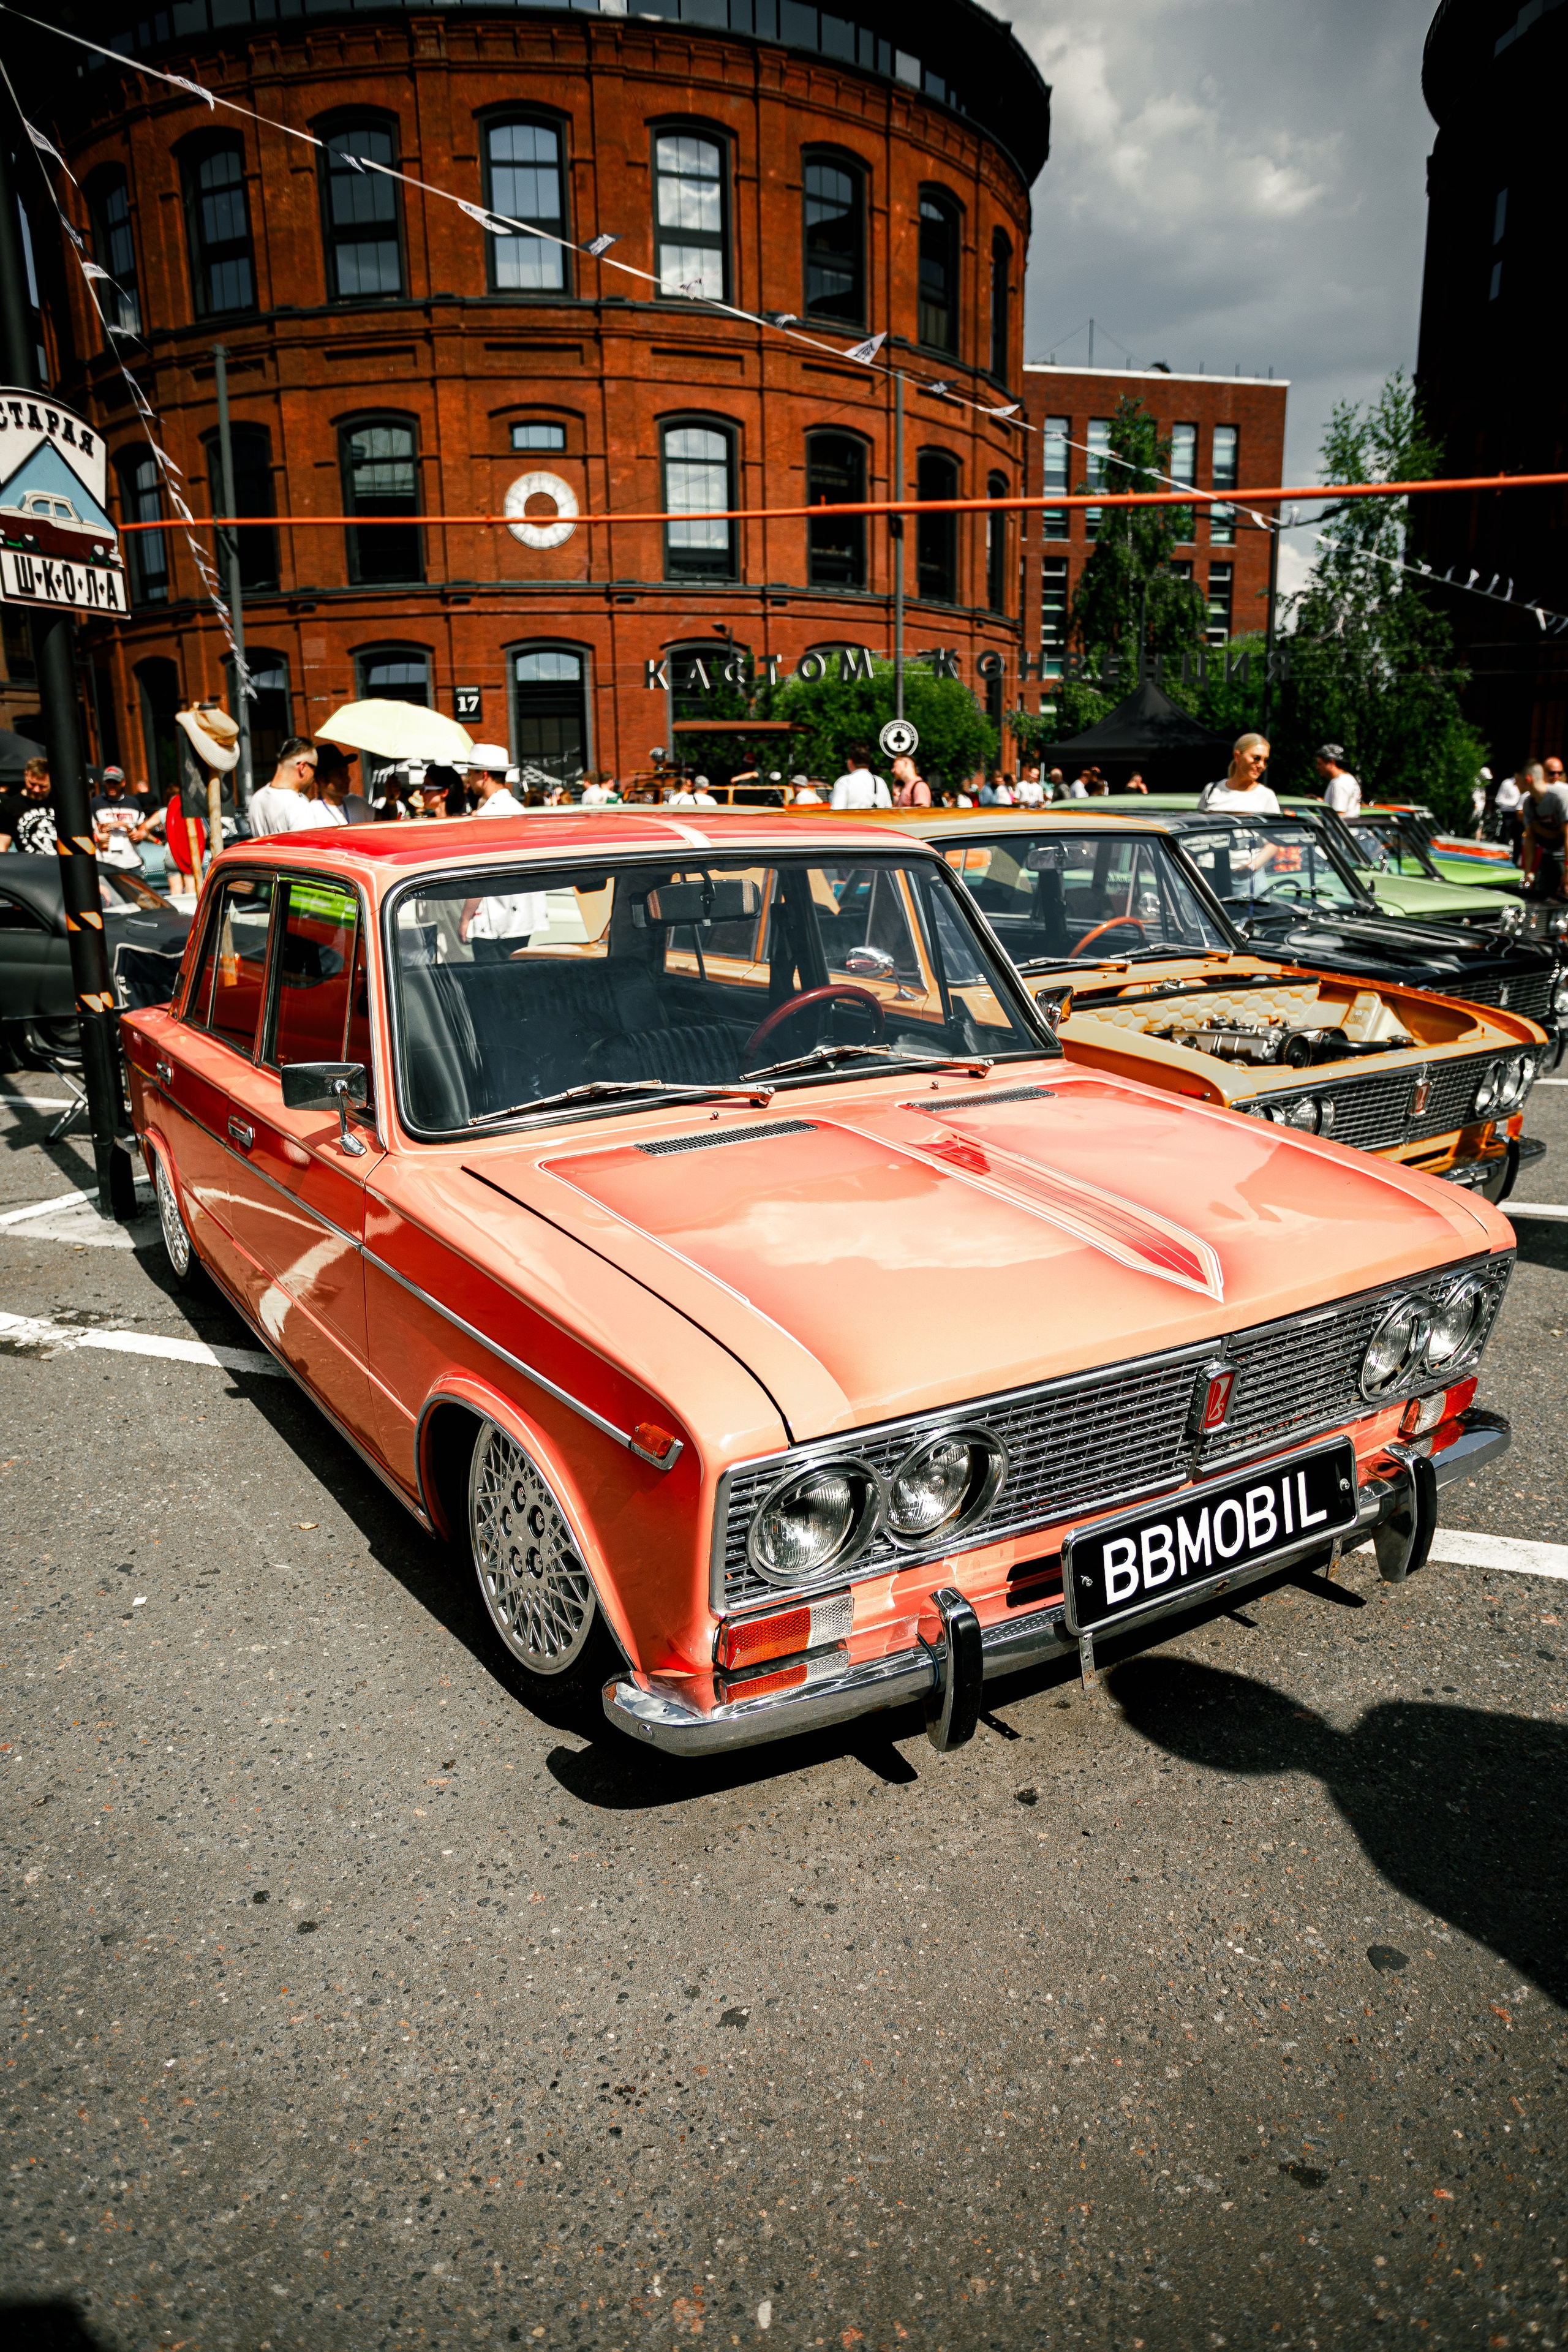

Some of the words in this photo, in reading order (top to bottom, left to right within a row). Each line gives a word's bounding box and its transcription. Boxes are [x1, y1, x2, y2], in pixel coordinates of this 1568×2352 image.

[644, 648, 874, 690] КАСТОМ
[933, 647, 1292, 690] КОНВЕНЦИЯ
[457, 695, 480, 712] 17
[1102, 1471, 1328, 1605] BBMOBIL
